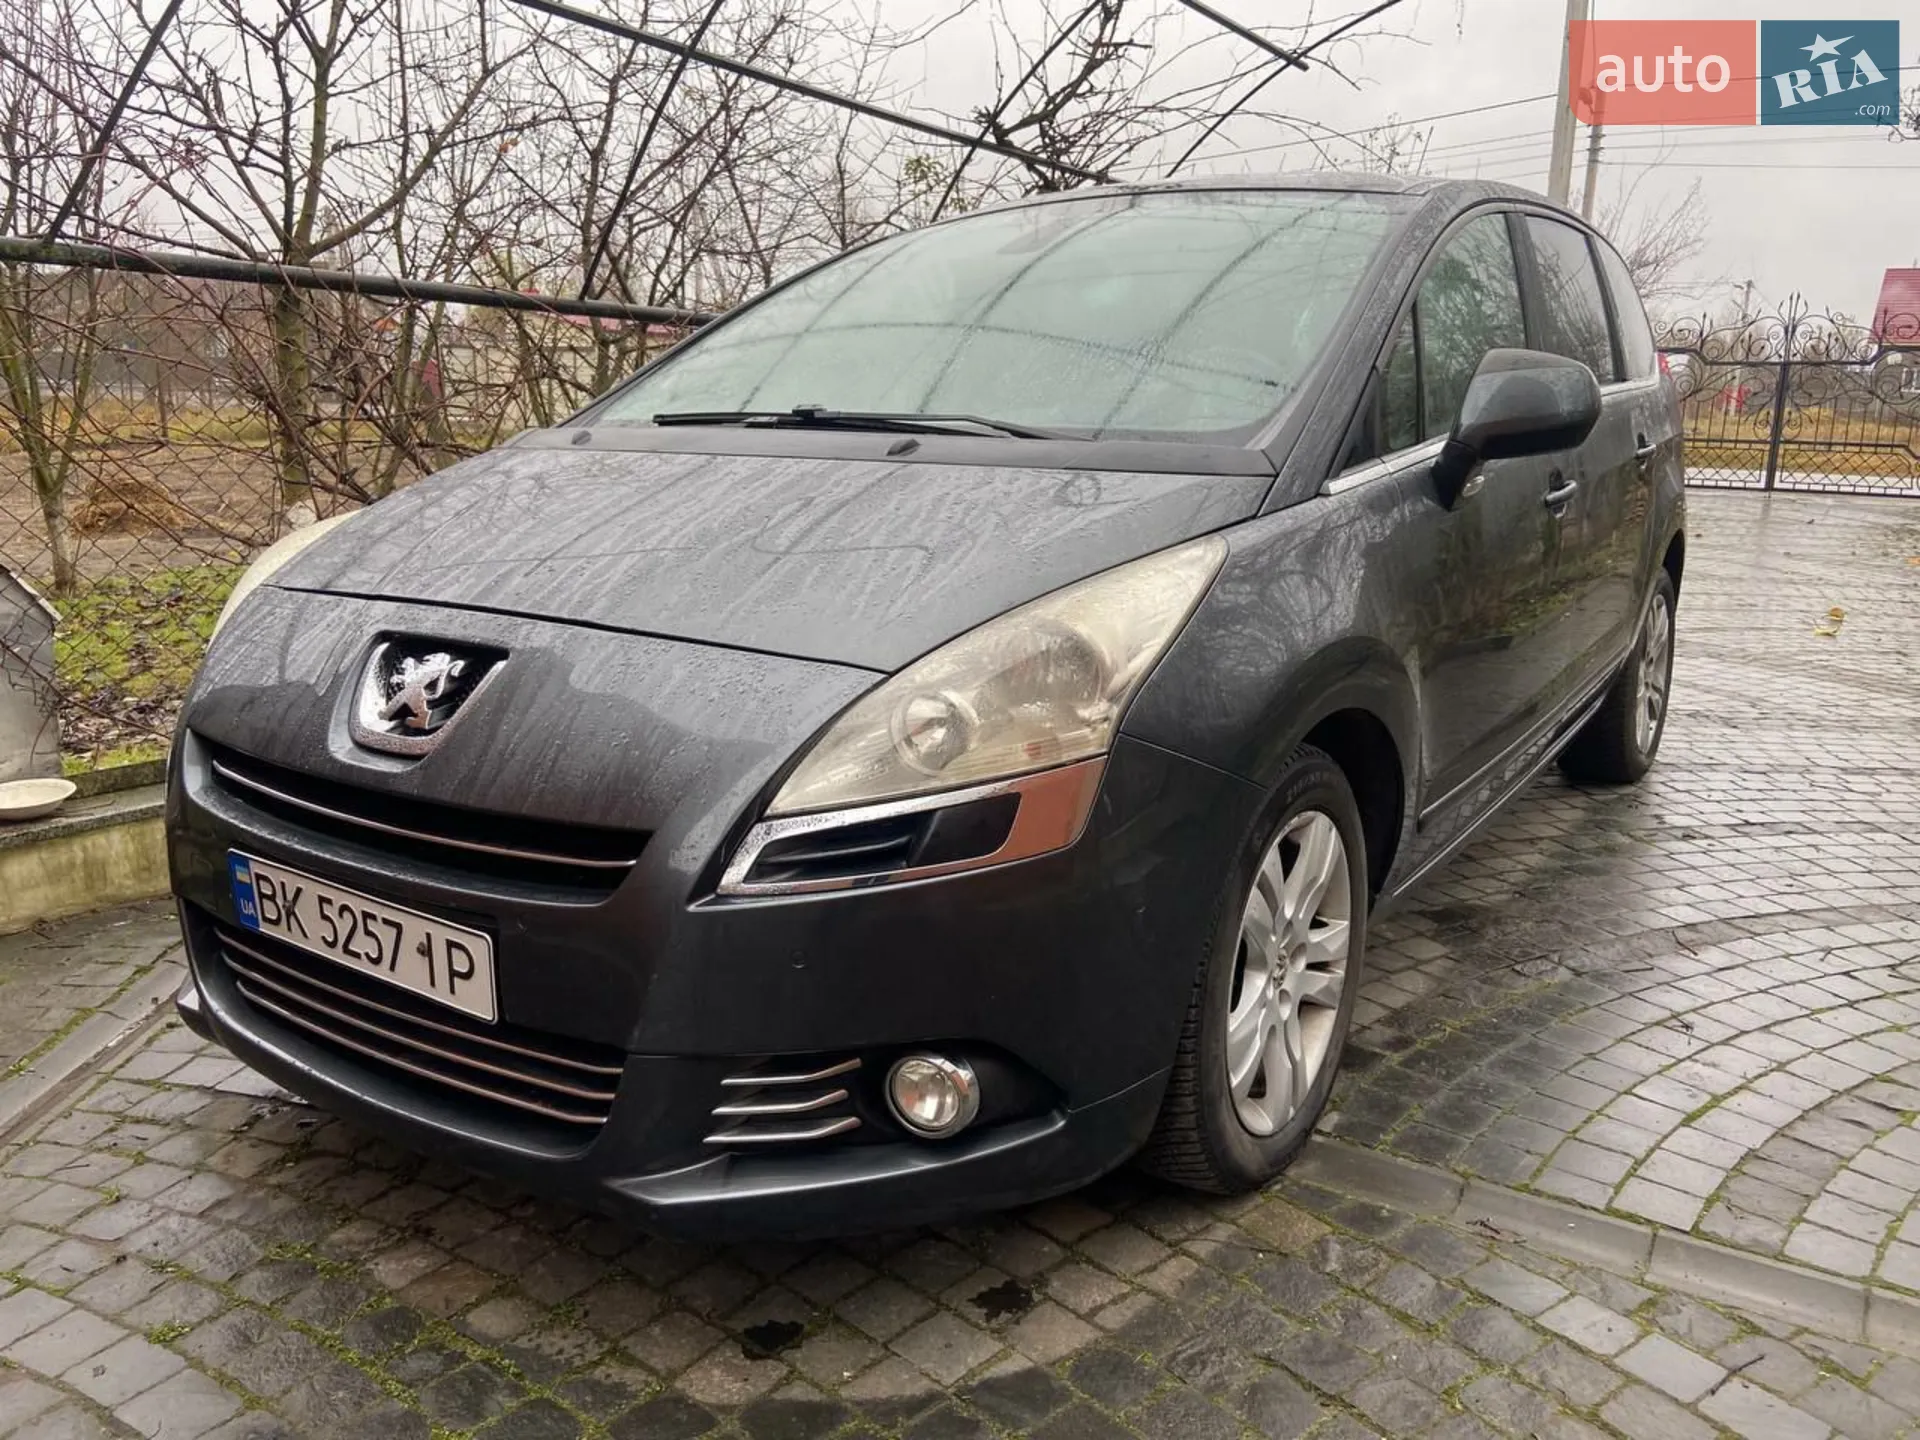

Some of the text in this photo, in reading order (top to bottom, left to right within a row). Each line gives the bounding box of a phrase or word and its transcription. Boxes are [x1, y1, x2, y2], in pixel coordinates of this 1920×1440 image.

[240, 898, 257, 919] UA
[254, 871, 476, 996] BK 5257 IP
